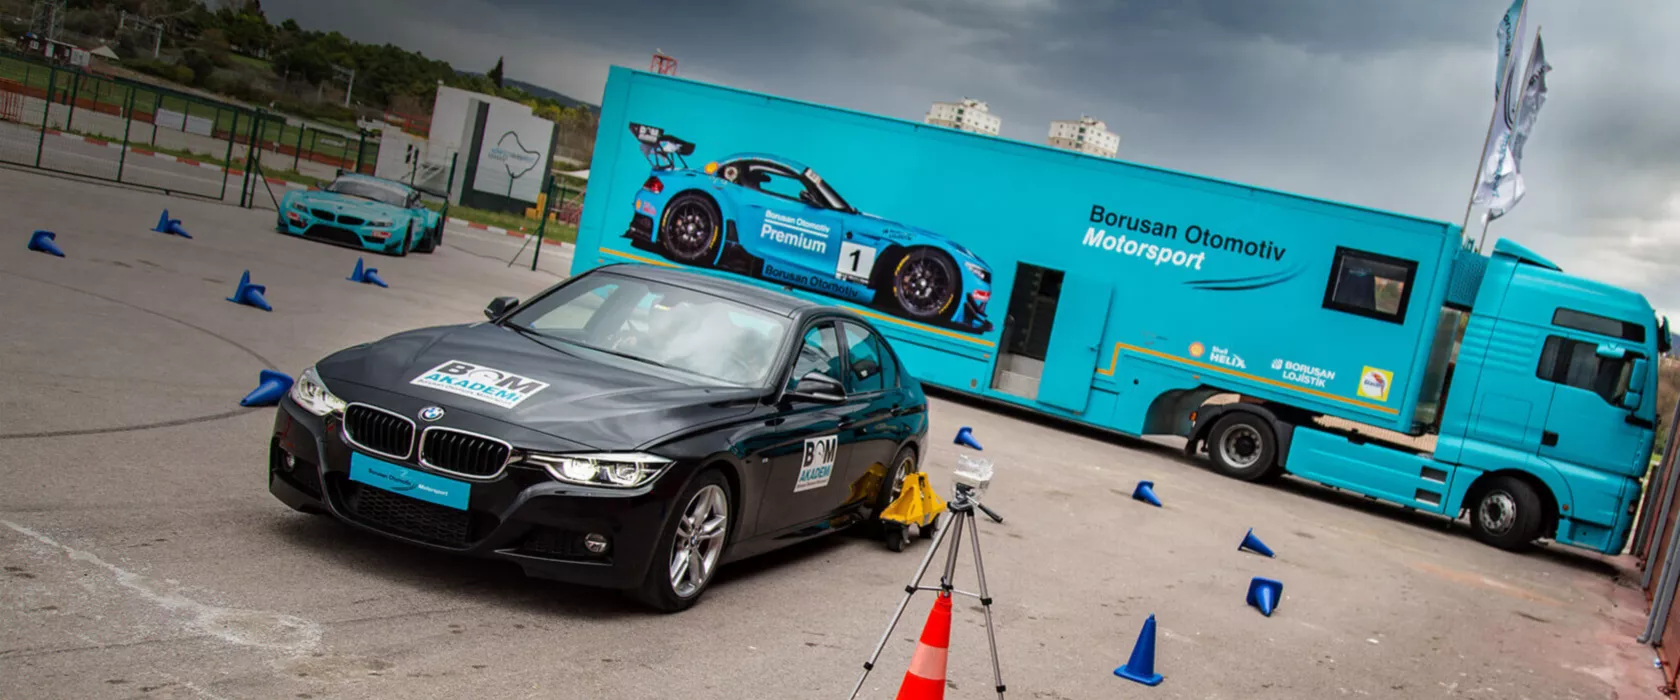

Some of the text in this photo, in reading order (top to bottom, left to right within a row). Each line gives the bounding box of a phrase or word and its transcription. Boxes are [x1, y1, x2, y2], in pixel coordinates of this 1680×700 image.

[765, 209, 831, 234] Borusan Otomotiv
[1089, 204, 1287, 262] Borusan Otomotiv
[760, 223, 827, 254] Premium
[1081, 227, 1206, 271] Motorsport
[849, 248, 861, 272] 1
[765, 264, 808, 285] Borusan
[809, 275, 859, 298] Otomotiv
[1285, 360, 1336, 380] BORUSAN
[418, 483, 449, 497] Motorsport
